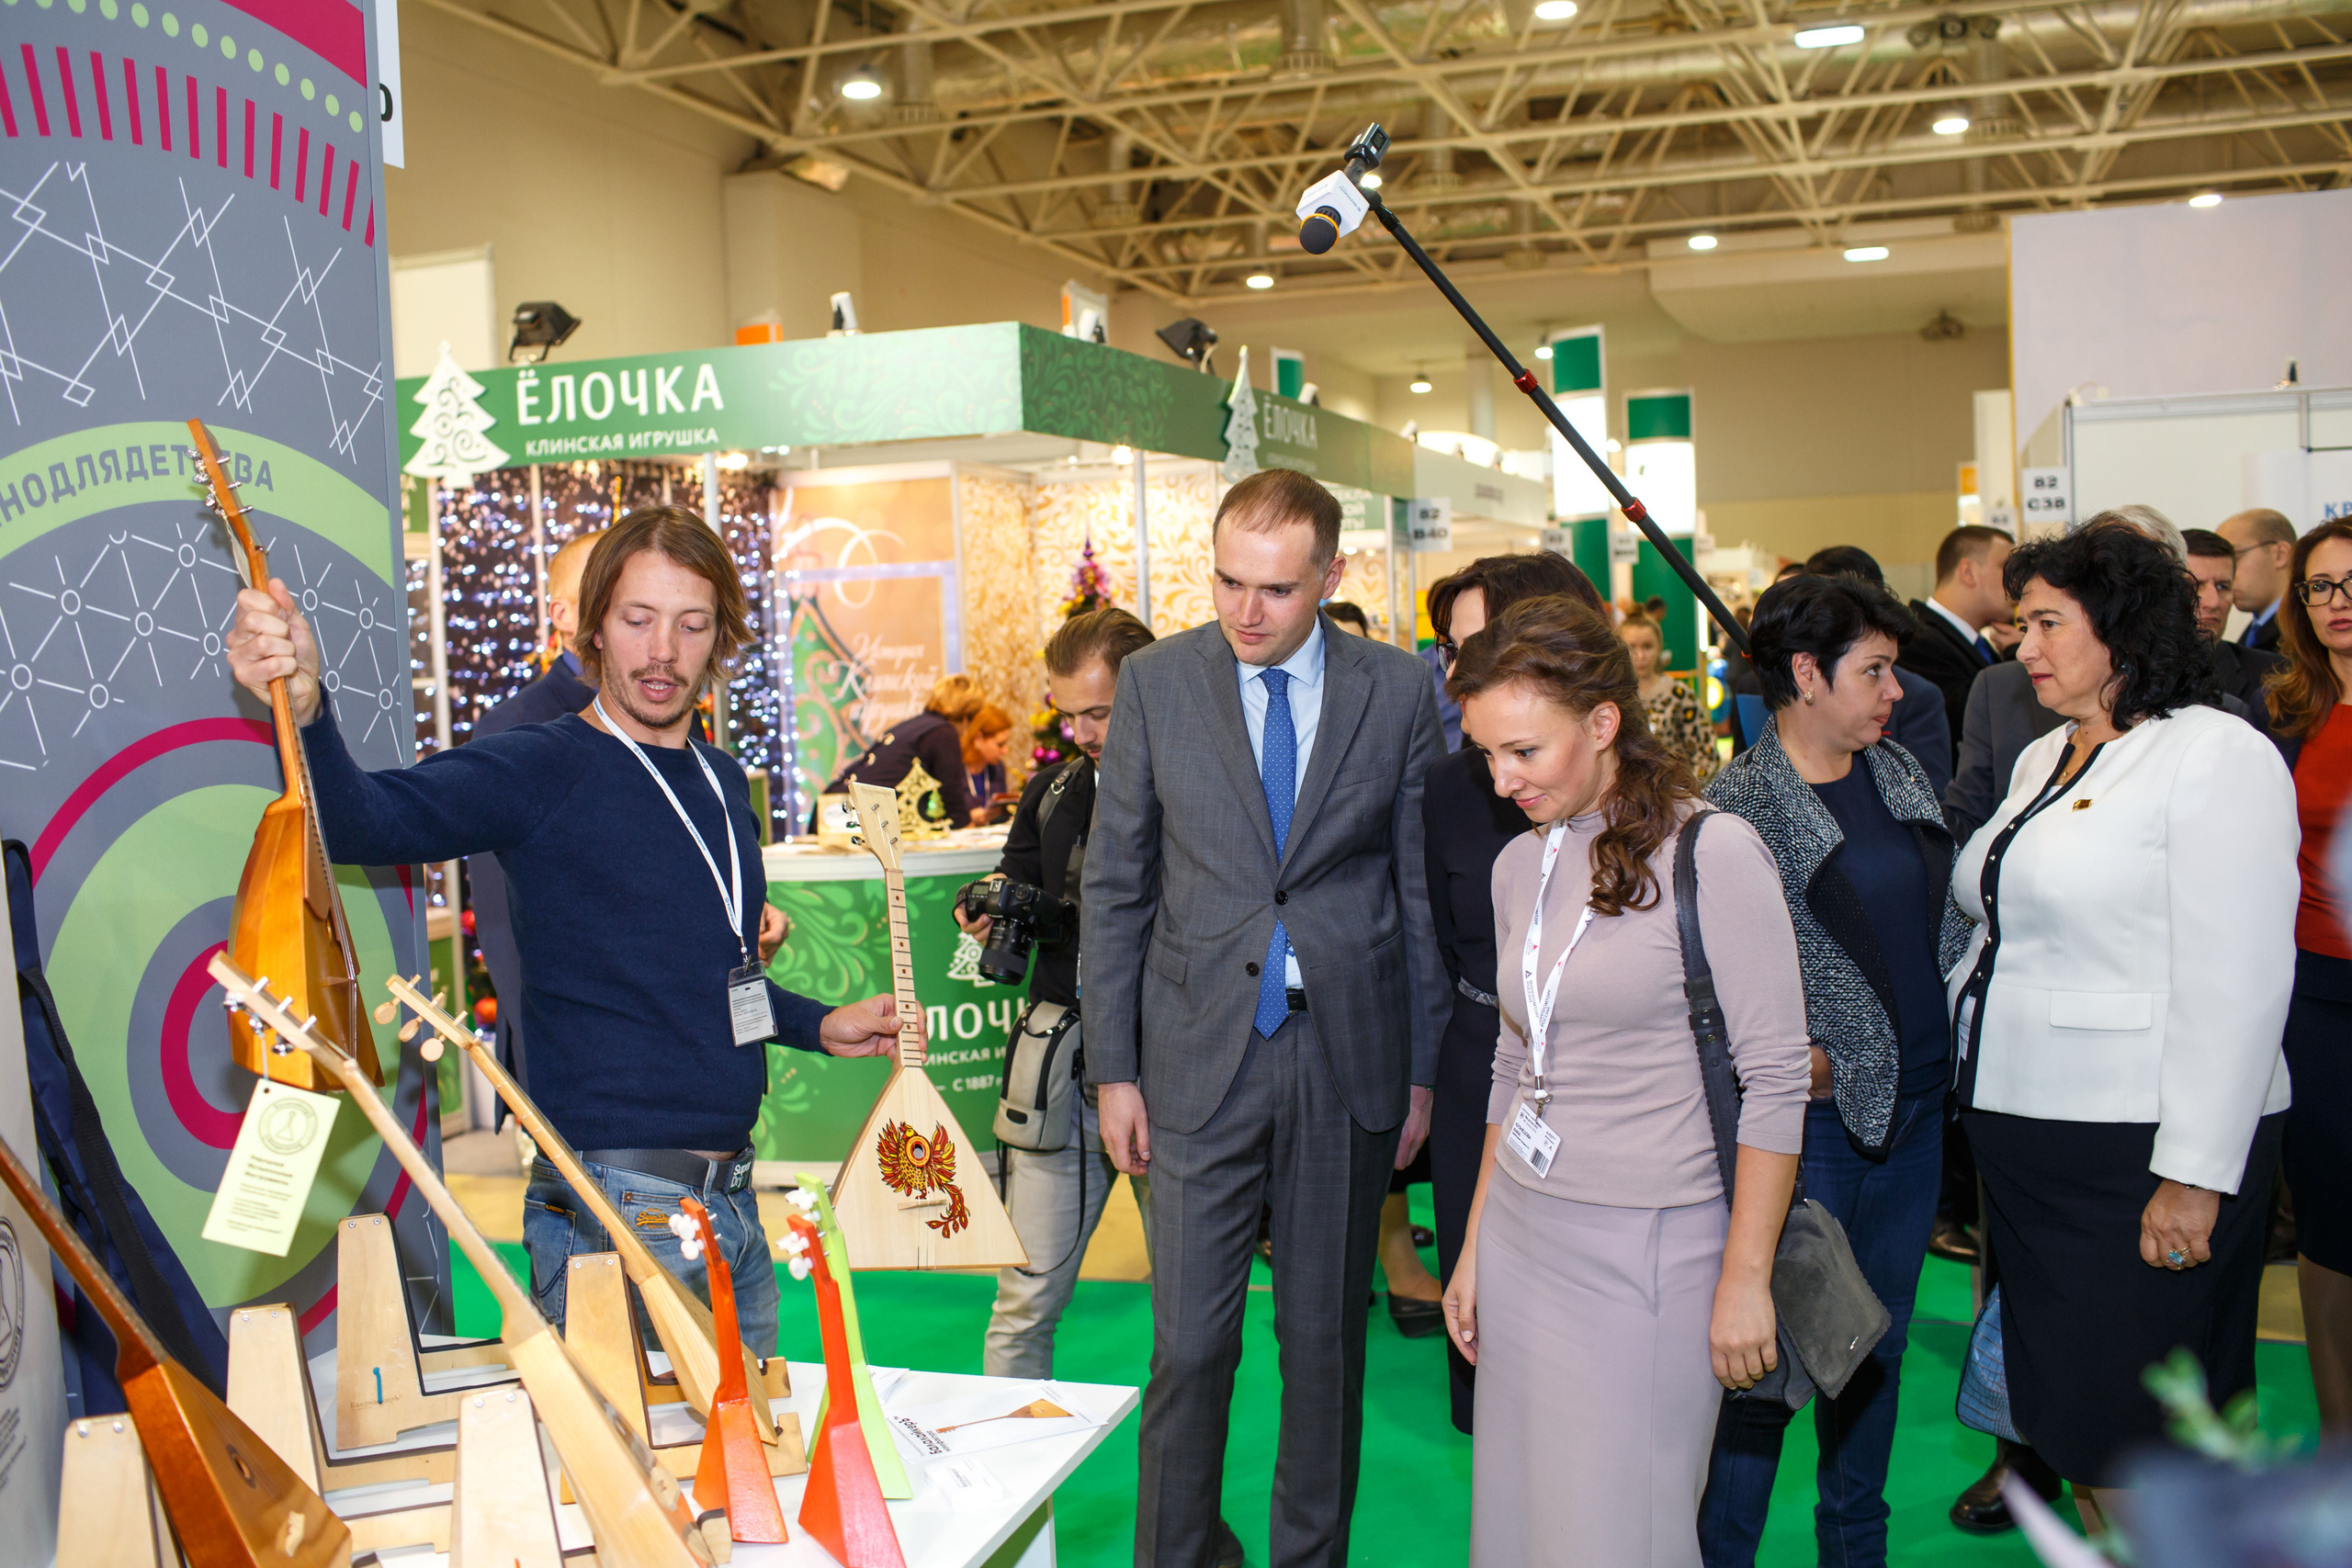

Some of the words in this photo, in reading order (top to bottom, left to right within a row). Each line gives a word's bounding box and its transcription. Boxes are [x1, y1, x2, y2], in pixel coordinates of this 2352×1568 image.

[516, 364, 724, 425] ЁЛОЧКА
[1263, 395, 1318, 450] ЁЛОЧКА
[526, 433, 624, 457] КЛИНСКАЯ
[629, 427, 719, 449] ИГРУШКА
[923, 1047, 991, 1066] ИНСКАЯ
[966, 1074, 994, 1090] 1887
